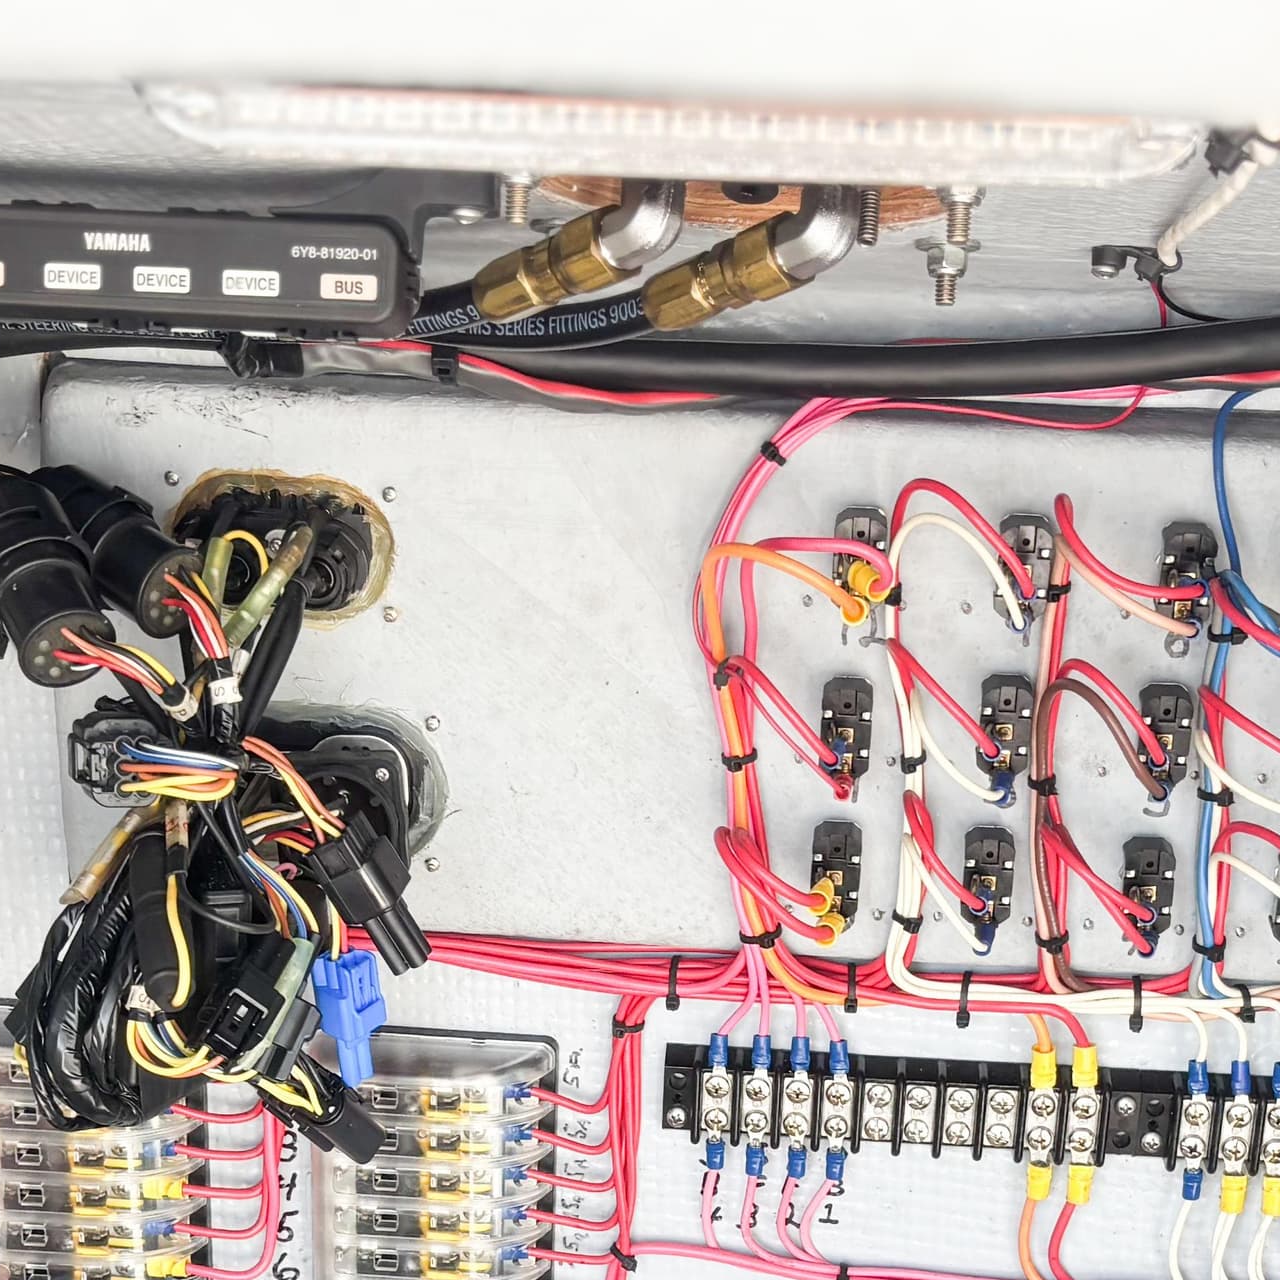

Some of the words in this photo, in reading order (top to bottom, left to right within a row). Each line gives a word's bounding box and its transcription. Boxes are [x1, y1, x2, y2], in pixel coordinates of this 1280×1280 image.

[84, 232, 151, 252] YAMAHA
[291, 245, 378, 261] 6Y8-81920-01
[47, 269, 98, 285] DEVICE
[136, 272, 188, 288] DEVICE
[225, 276, 277, 292] DEVICE
[334, 280, 364, 295] BUS
[495, 320, 546, 337] SERIES
[548, 307, 608, 336] FITTINGS
[818, 1202, 840, 1225] 1
[275, 1209, 300, 1243] 5
